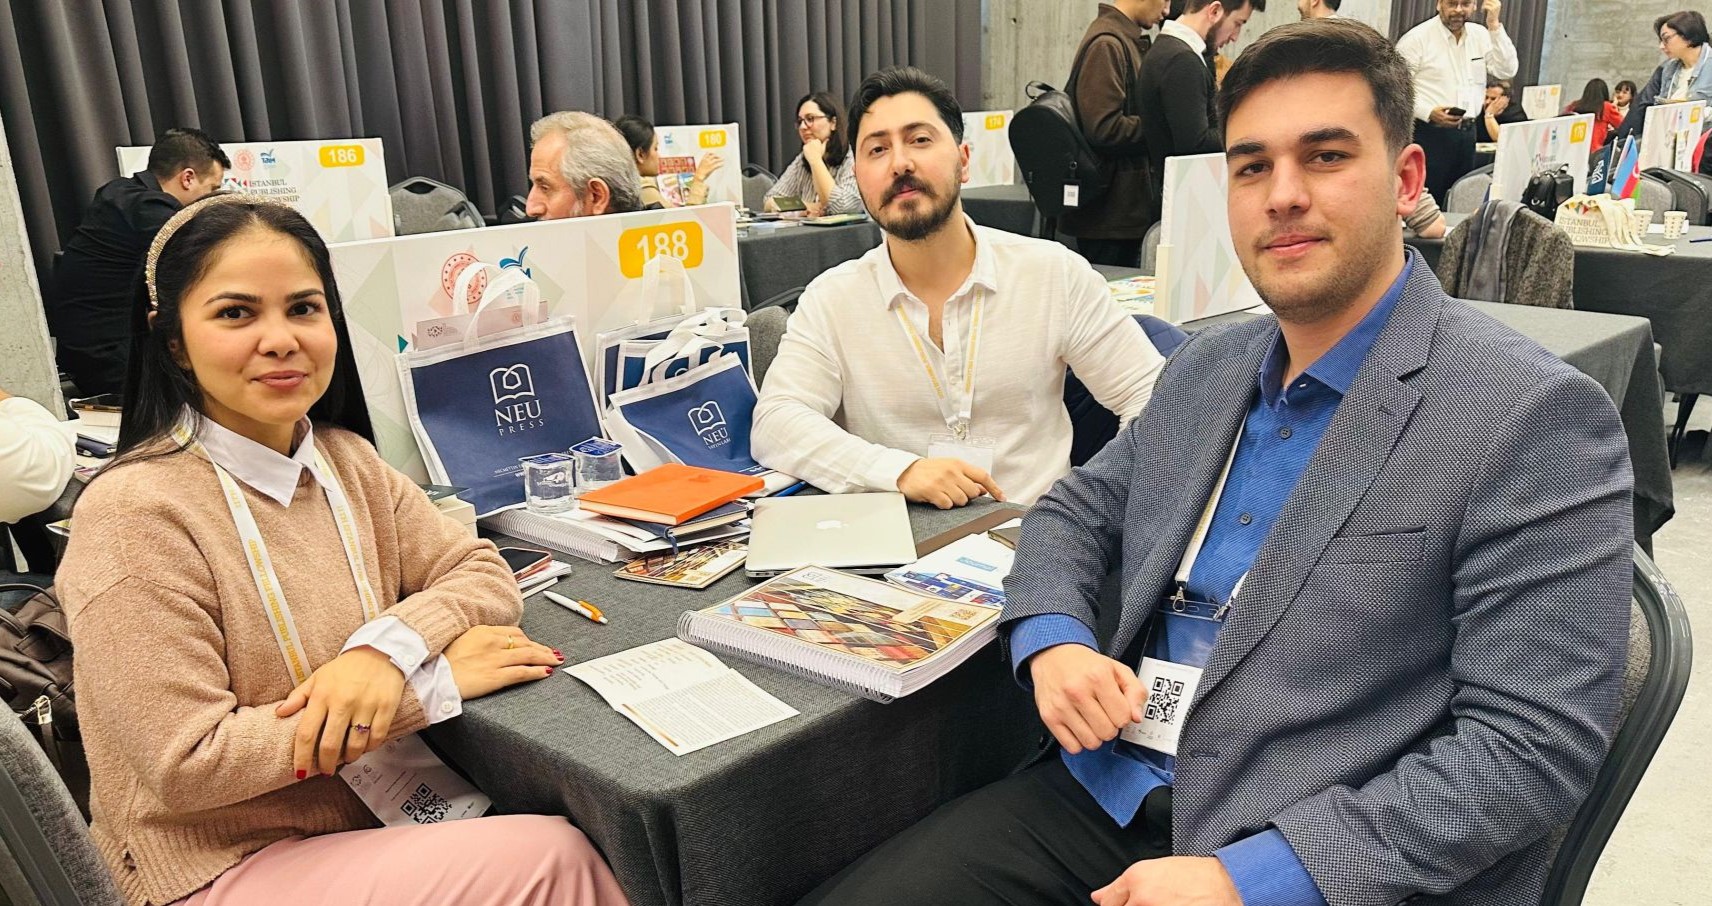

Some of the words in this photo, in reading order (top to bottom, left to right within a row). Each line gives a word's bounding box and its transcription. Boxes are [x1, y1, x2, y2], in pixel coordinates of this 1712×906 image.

[329, 149, 357, 163] 186
[637, 229, 689, 263] 188
[494, 399, 541, 427] NEU
[498, 418, 544, 437] PRESS
[266, 592, 291, 643] PUBLISHING
